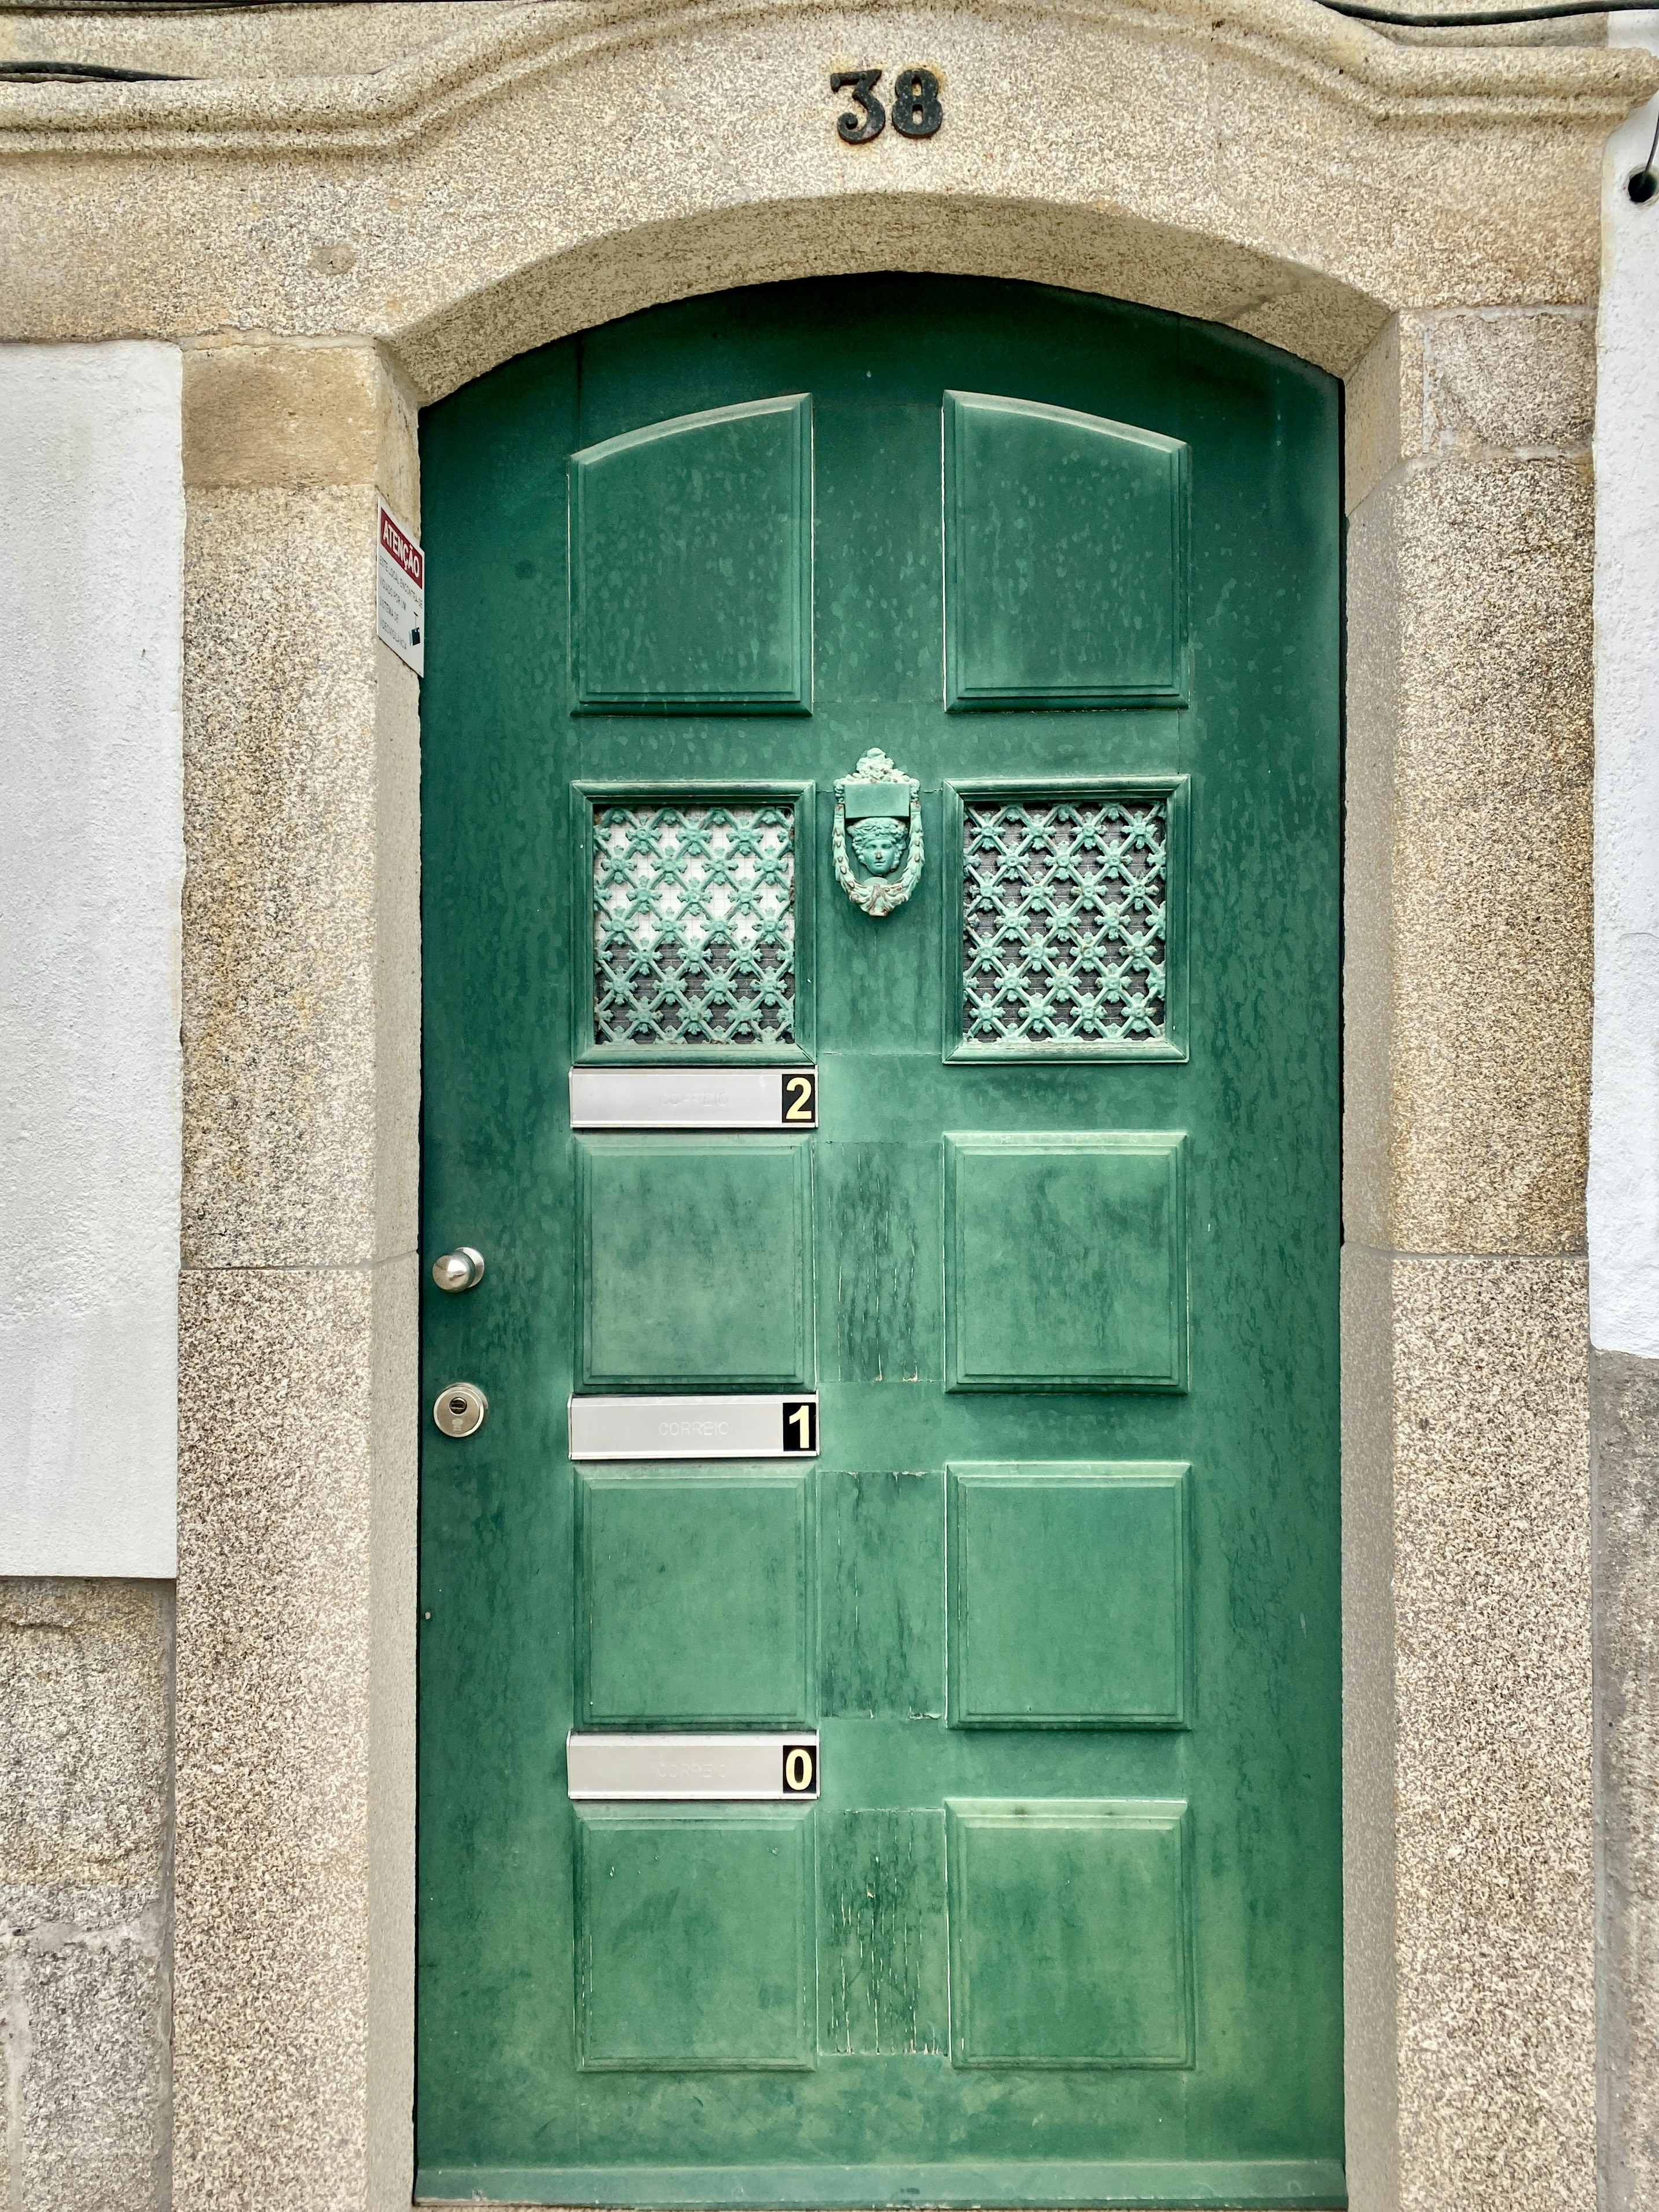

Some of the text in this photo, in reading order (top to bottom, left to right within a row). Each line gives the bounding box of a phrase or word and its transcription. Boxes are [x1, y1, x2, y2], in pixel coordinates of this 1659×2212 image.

[831, 68, 943, 145] 38
[383, 520, 420, 578] ATENÇÃO
[659, 1092, 729, 1106] CORREIO
[786, 1077, 812, 1119] 2
[659, 1421, 729, 1435] CORREIO
[789, 1405, 809, 1449] 1
[658, 1763, 728, 1778] CORREIO
[786, 1749, 812, 1790] 0
